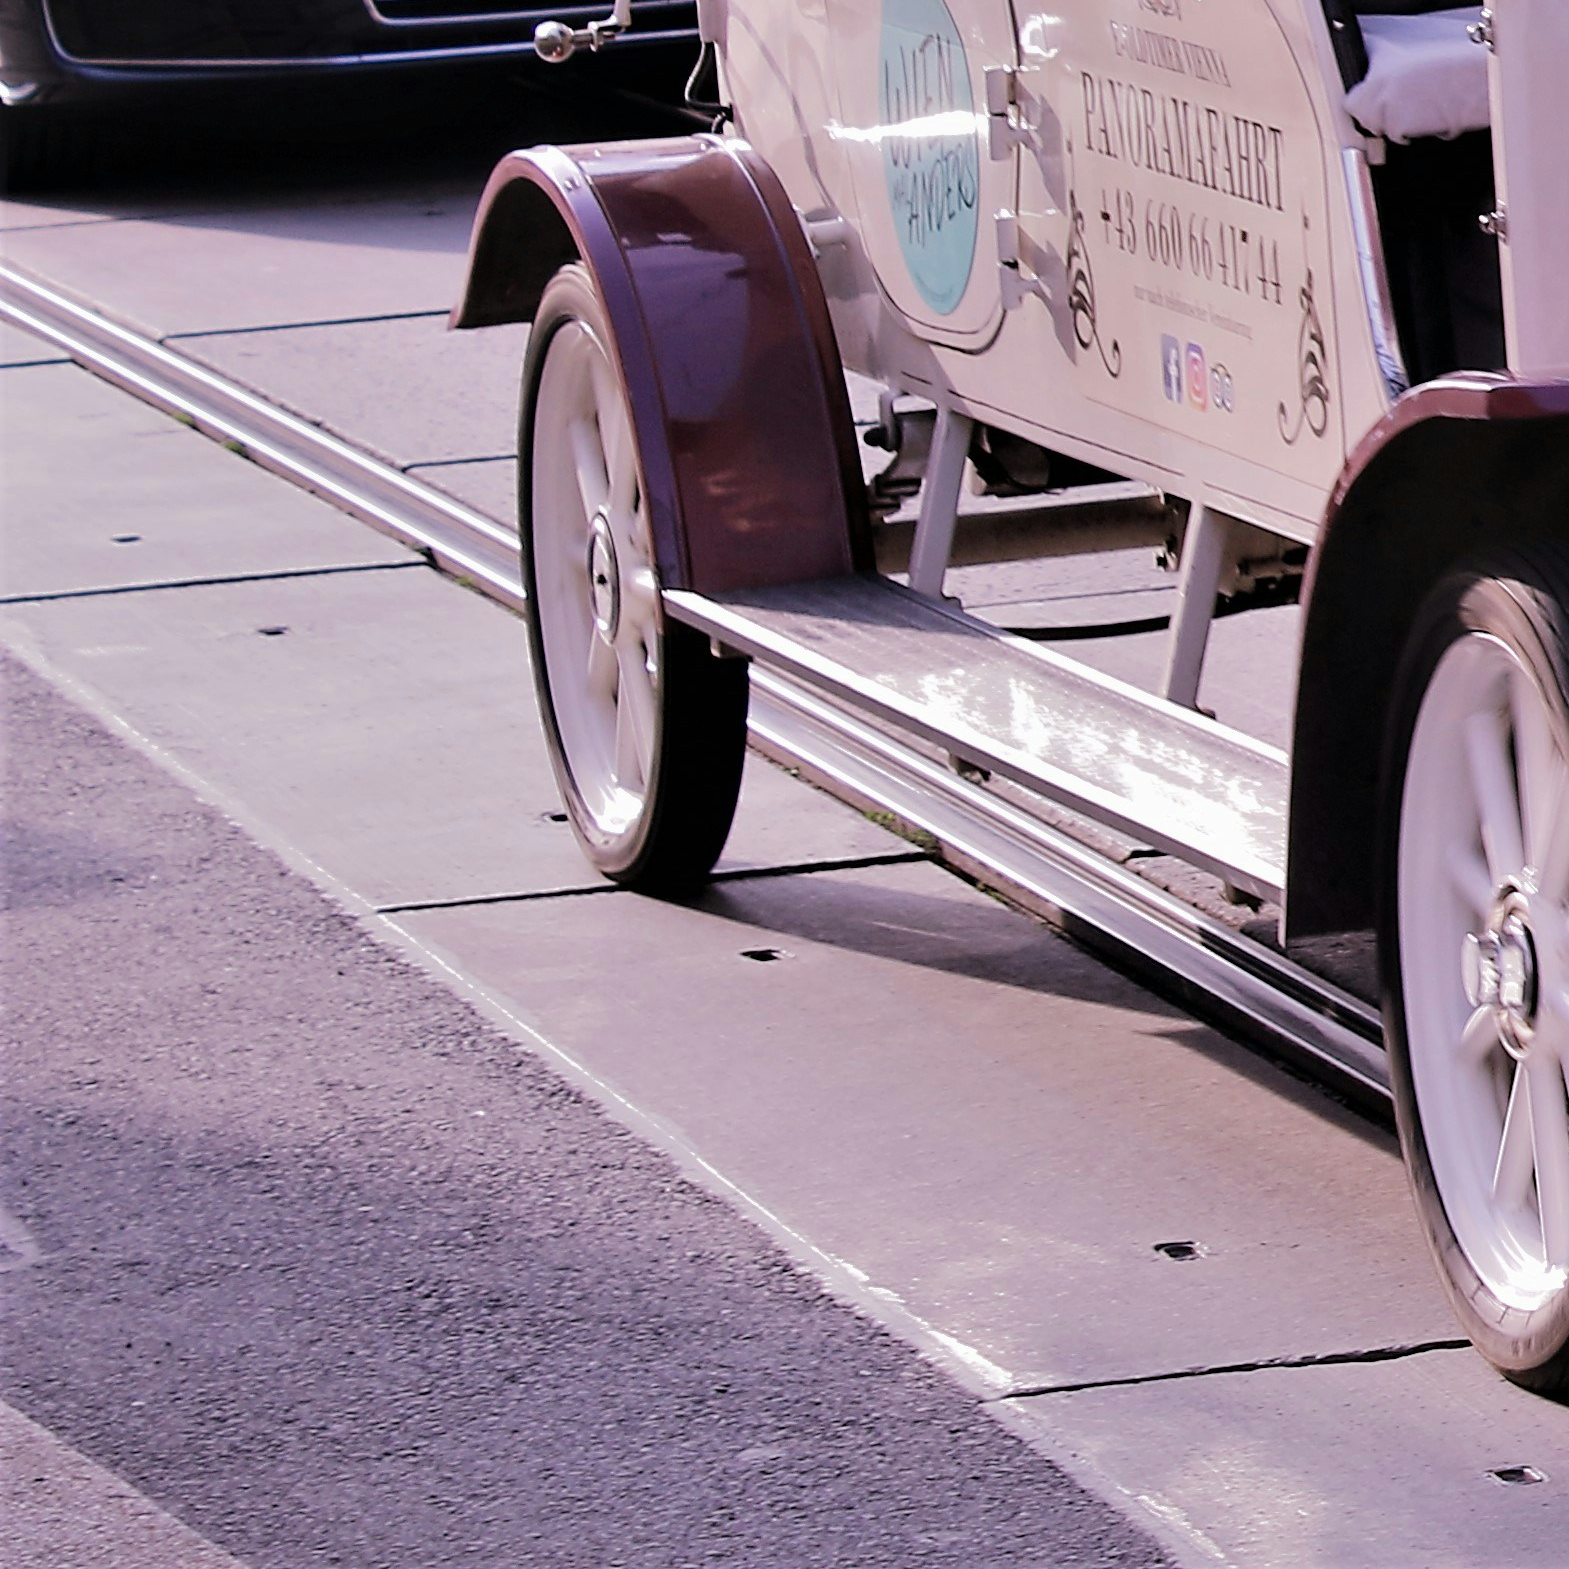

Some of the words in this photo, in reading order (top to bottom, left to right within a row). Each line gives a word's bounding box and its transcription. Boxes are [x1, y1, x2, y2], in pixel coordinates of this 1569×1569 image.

[1183, 40, 1231, 87] VIENNA
[907, 138, 976, 248] ANDERS
[1081, 71, 1284, 212] PANORAMAFAHRT
[1101, 188, 1137, 254] +43
[1146, 199, 1183, 270] 660
[1189, 213, 1212, 281] 66
[1258, 235, 1283, 305] 44
